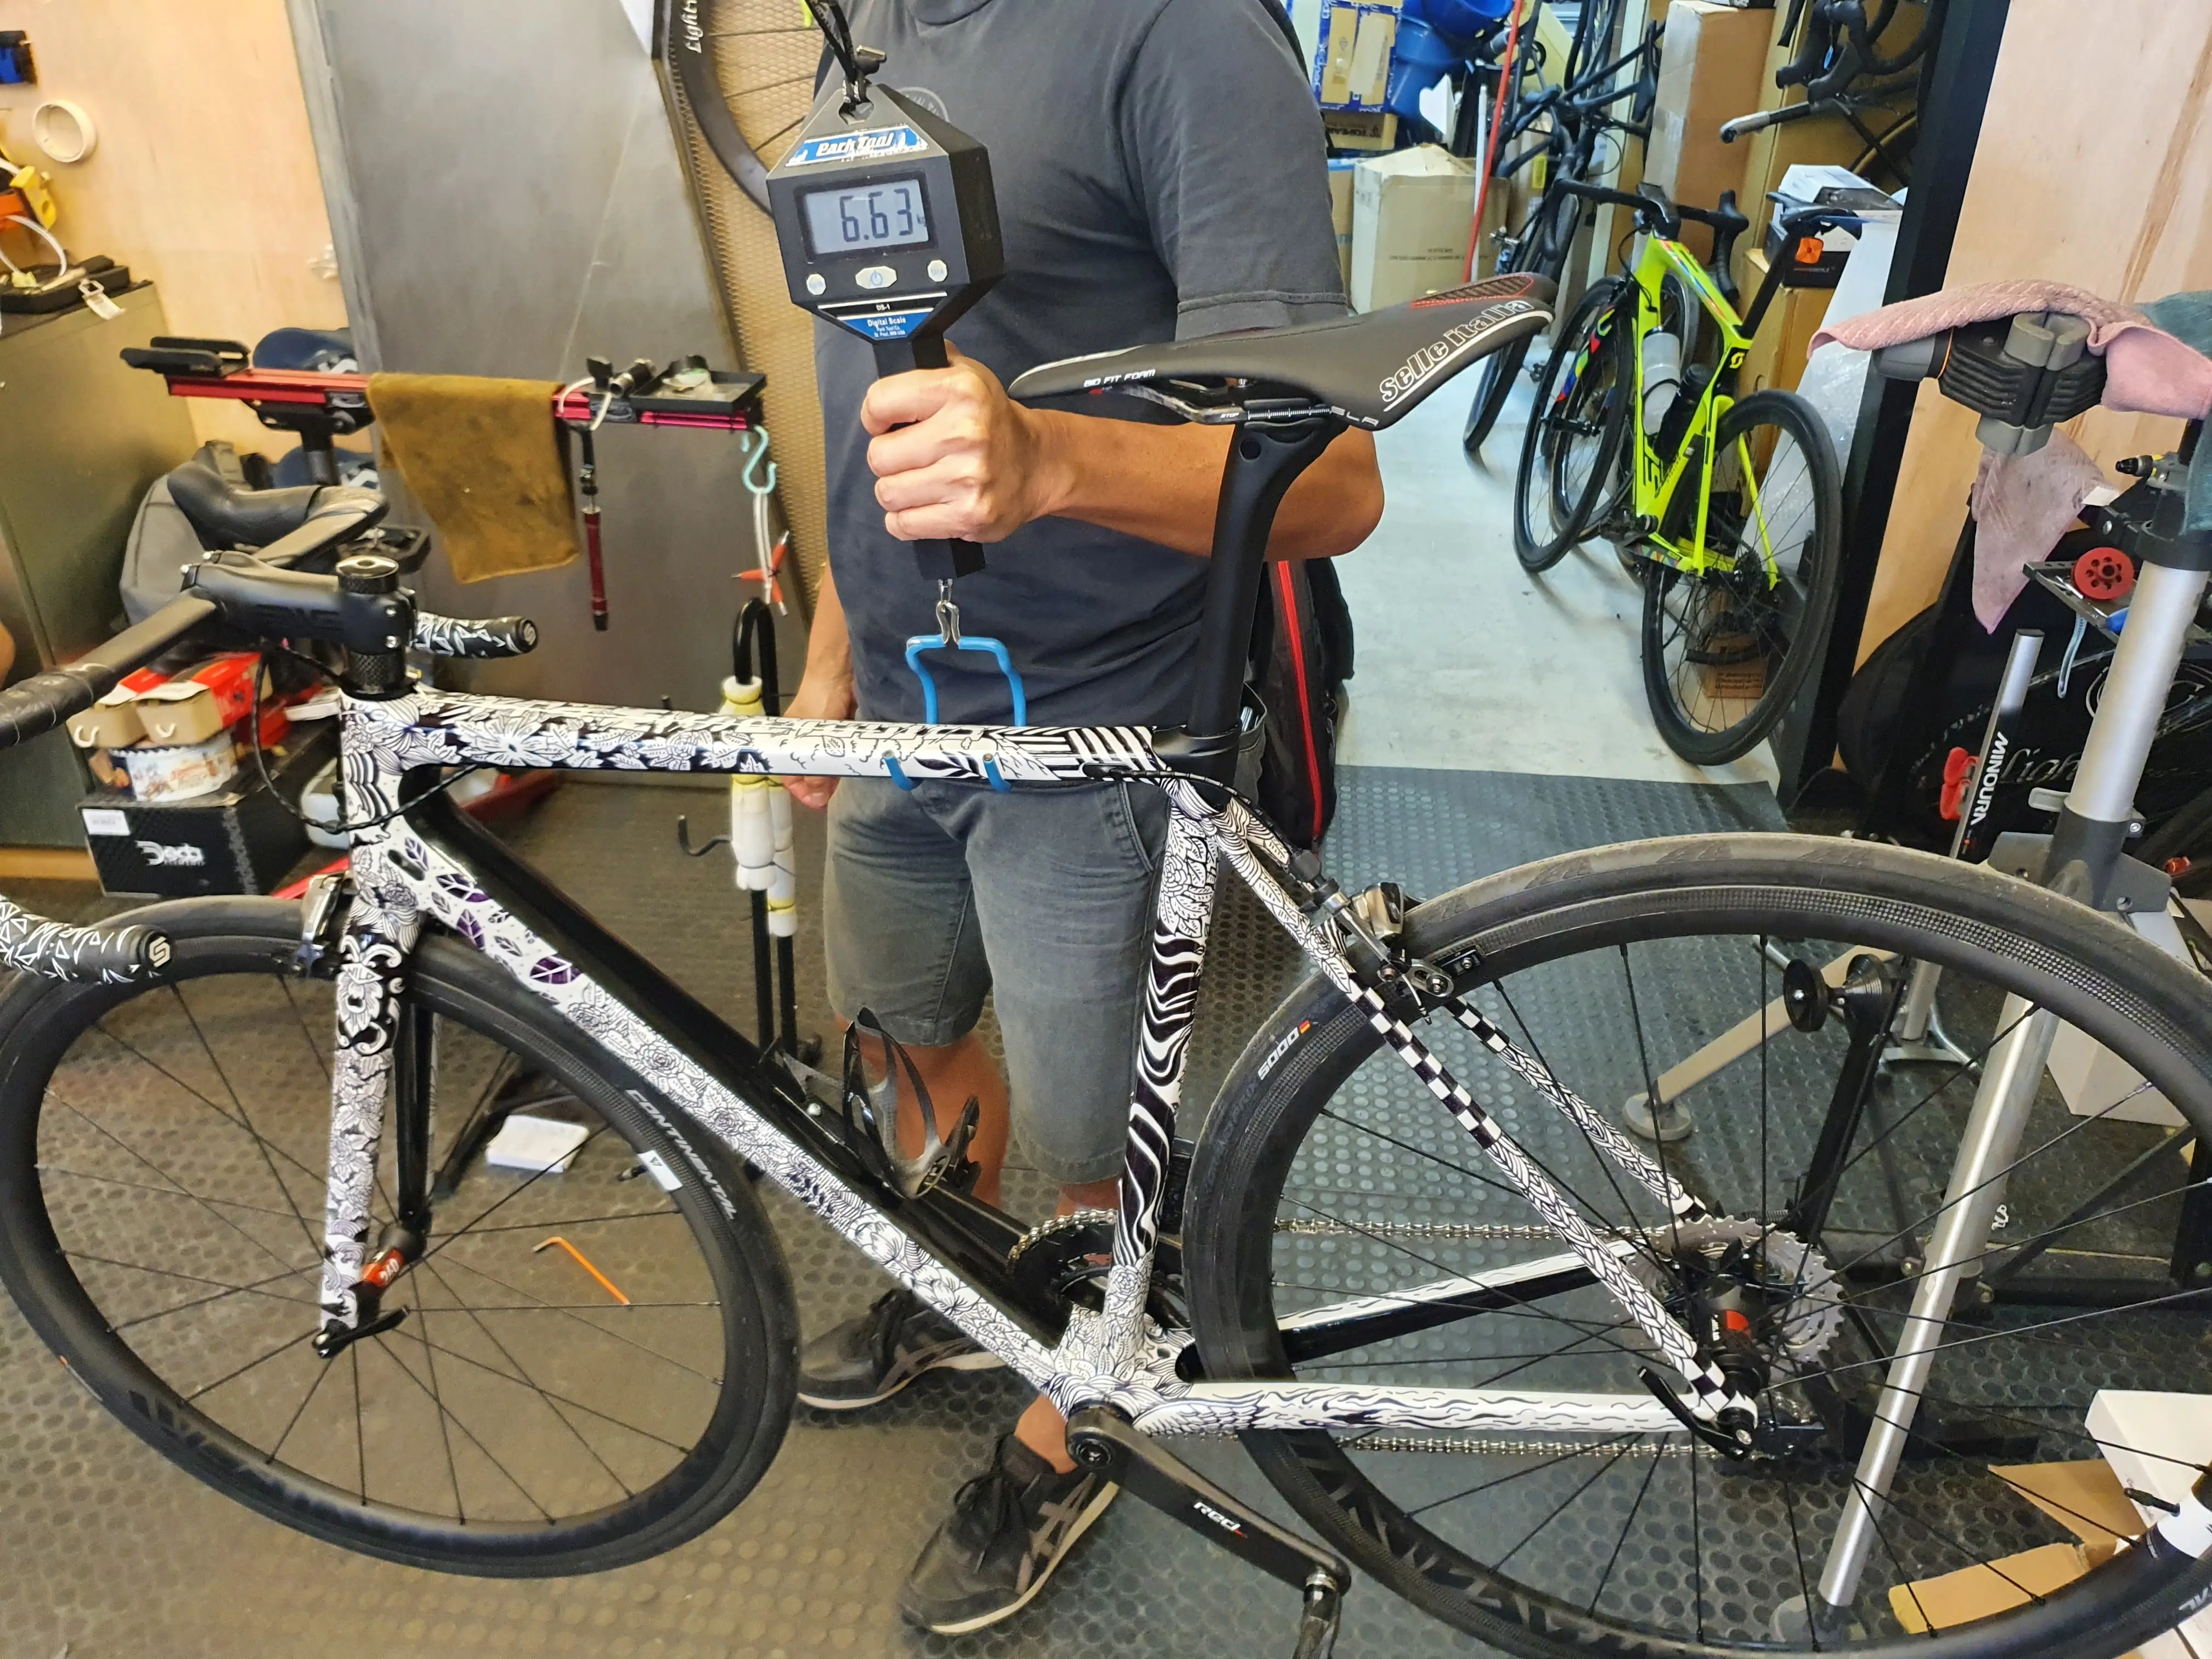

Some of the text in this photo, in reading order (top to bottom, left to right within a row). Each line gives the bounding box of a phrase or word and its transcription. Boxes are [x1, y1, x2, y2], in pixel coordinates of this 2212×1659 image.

[839, 188, 914, 242] 6.63
[867, 317, 906, 329] Digital Scale
[1084, 369, 1156, 388] BIO FIT FOAM
[1379, 300, 1534, 403] selle italia
[1970, 731, 2008, 826] MINOURA
[1257, 1026, 1300, 1081] 5000
[625, 1089, 737, 1220] CONTINENTAL
